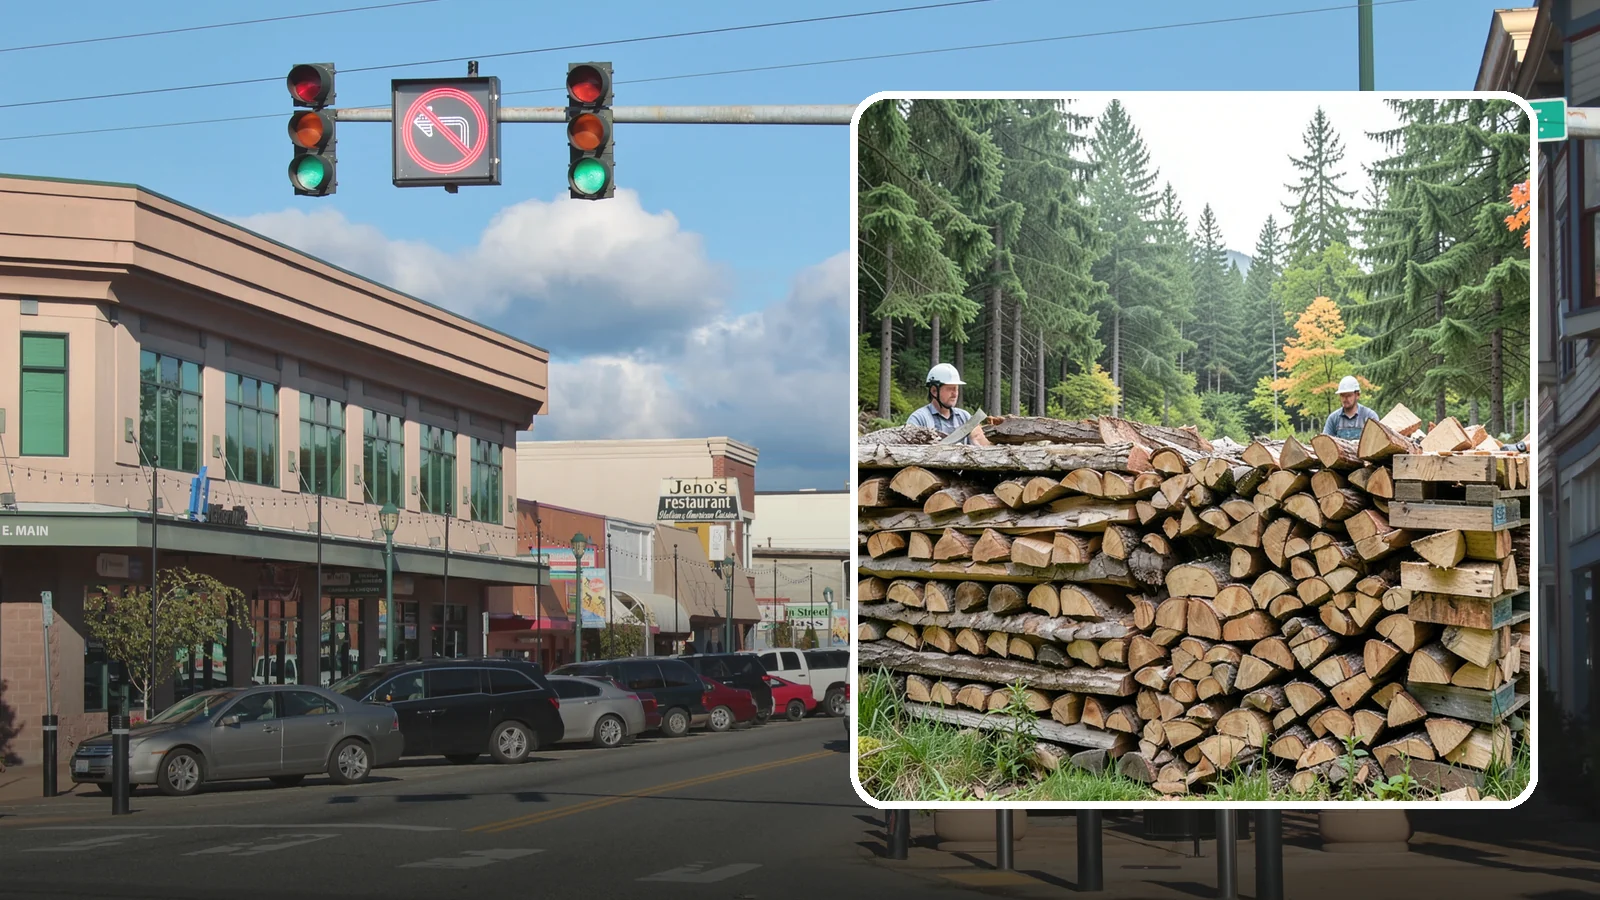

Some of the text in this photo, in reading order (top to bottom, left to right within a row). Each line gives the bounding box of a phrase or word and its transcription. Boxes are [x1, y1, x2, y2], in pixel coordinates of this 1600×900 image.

[669, 480, 727, 494] Jeno's
[665, 497, 731, 509] restaurant
[658, 510, 682, 519] Italian
[686, 510, 714, 519] American
[715, 509, 737, 519] Cuisine
[2, 525, 49, 536] E. MAIN
[797, 608, 828, 616] Street
